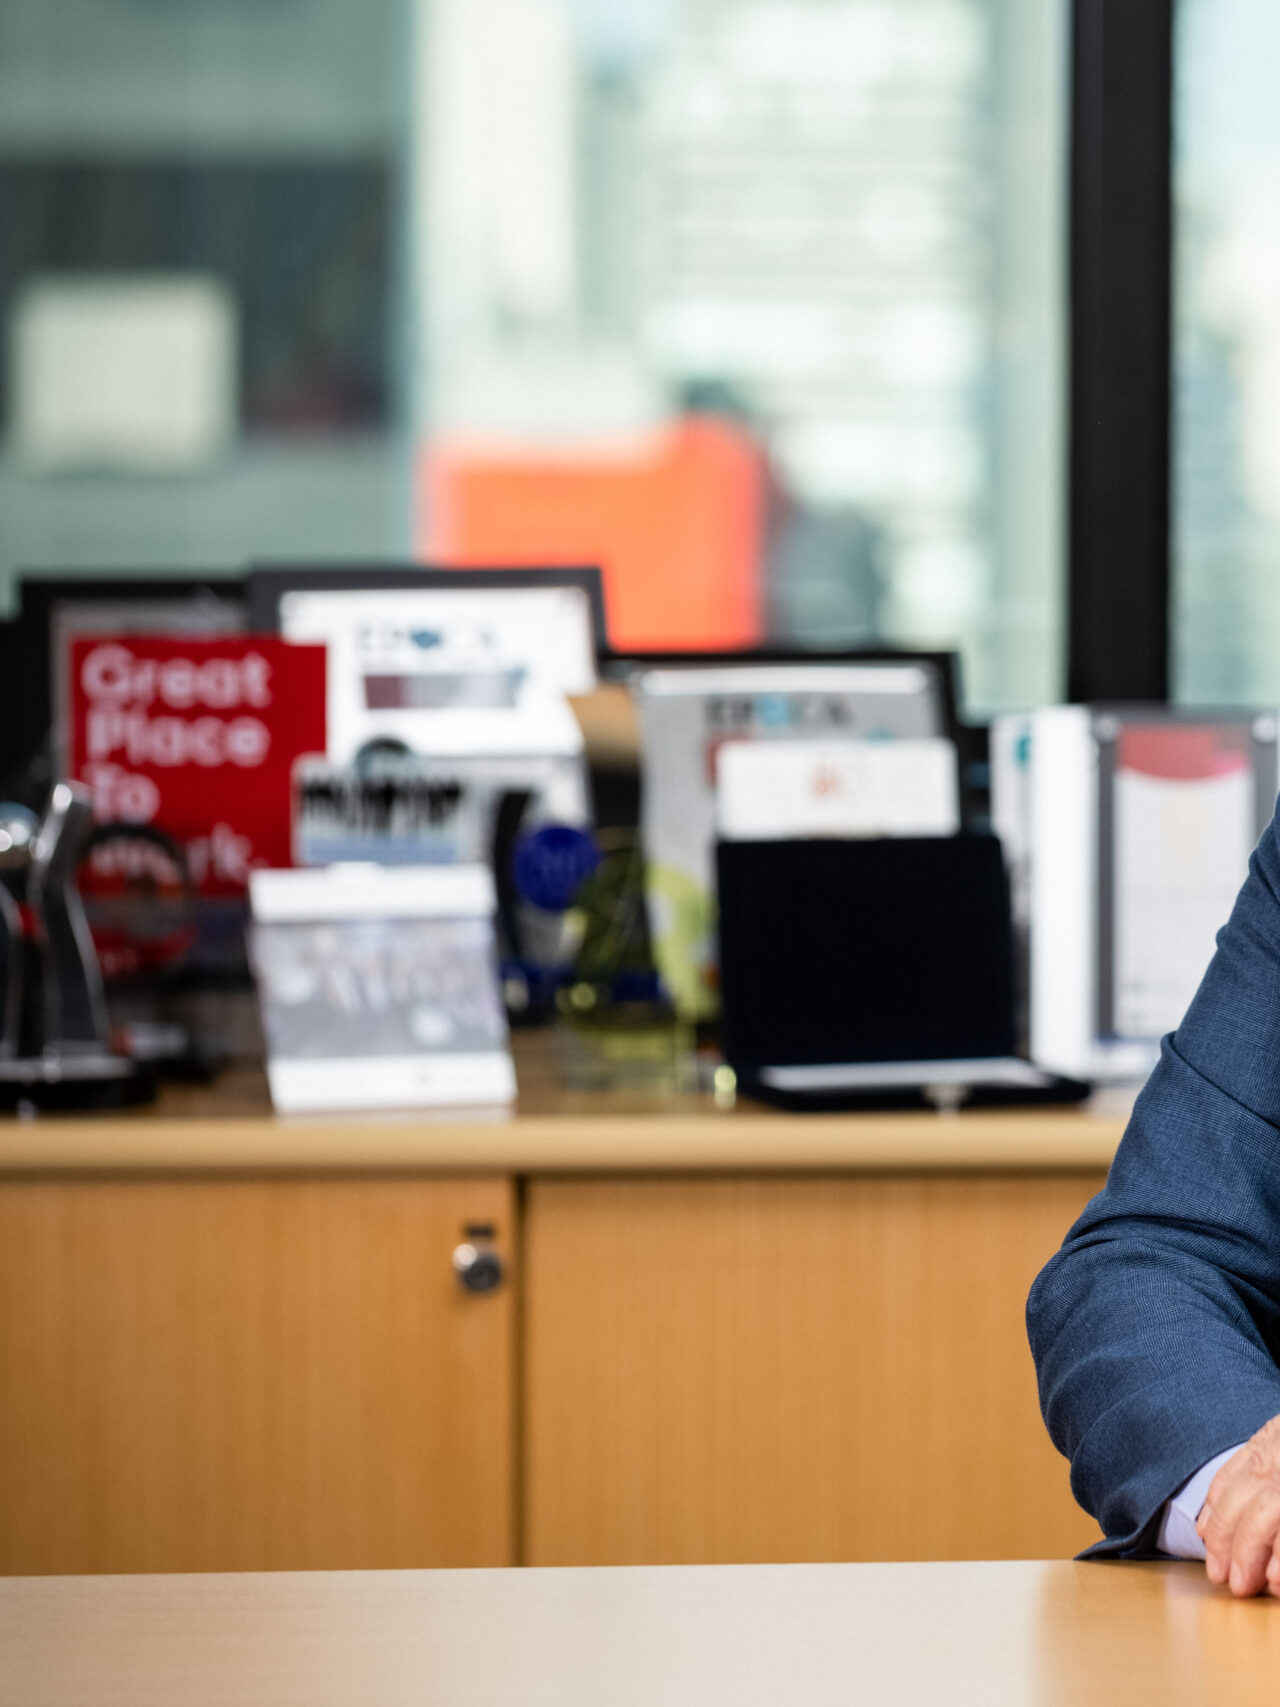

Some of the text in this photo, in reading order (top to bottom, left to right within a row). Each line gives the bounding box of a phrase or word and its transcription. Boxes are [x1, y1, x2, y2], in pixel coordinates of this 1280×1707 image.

[82, 643, 271, 709] Great
[87, 705, 271, 767] Place
[82, 762, 160, 824] To
